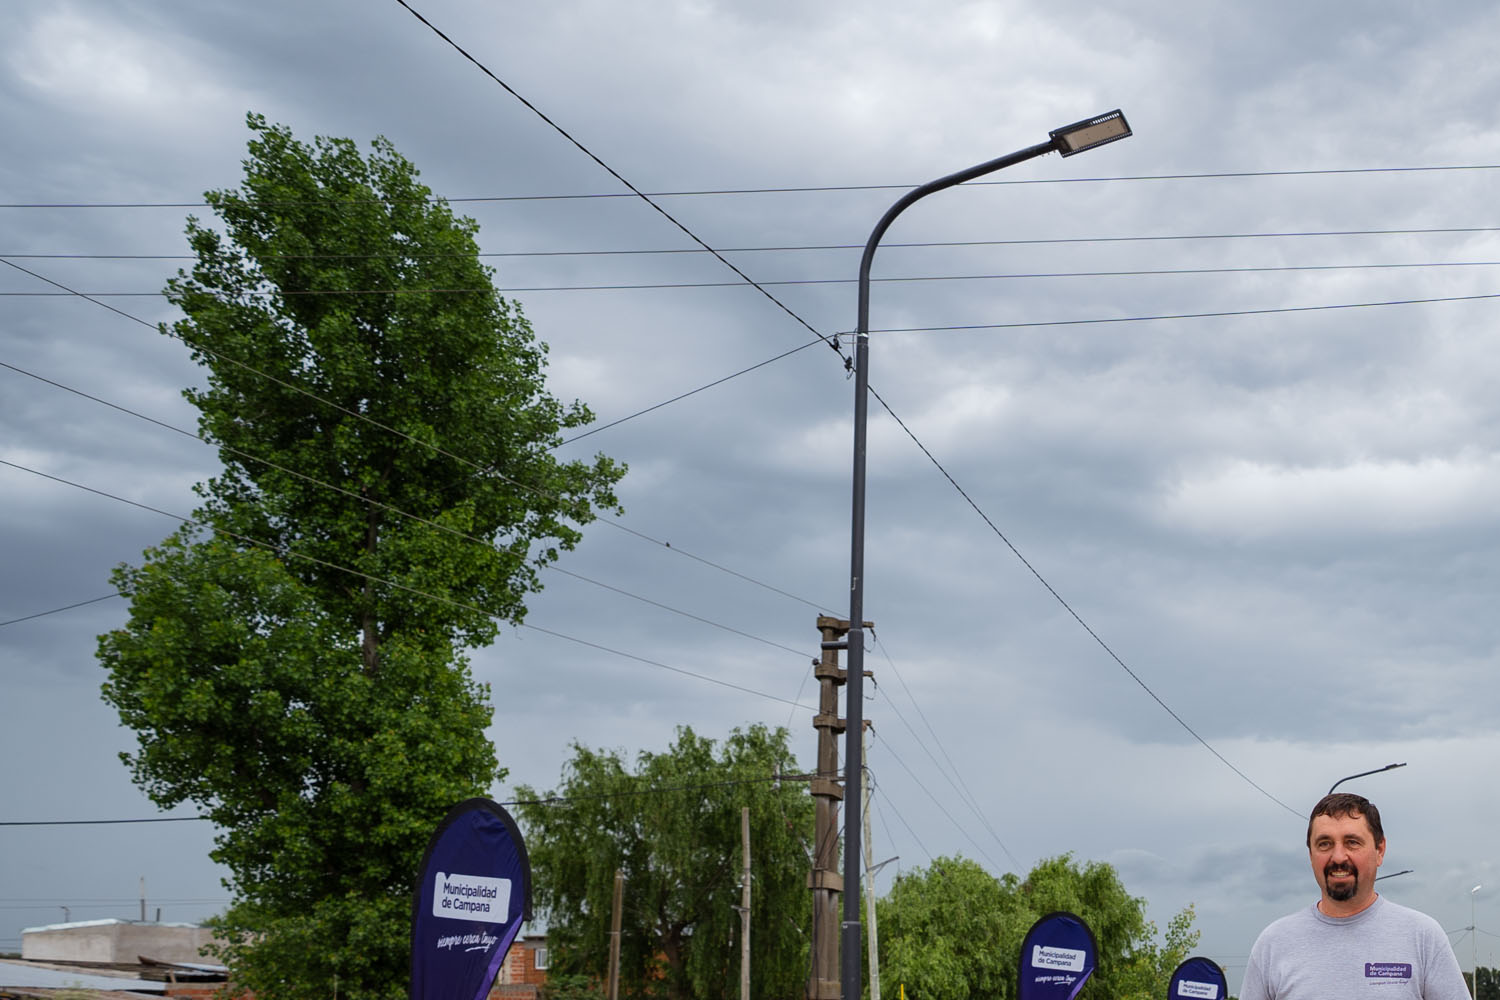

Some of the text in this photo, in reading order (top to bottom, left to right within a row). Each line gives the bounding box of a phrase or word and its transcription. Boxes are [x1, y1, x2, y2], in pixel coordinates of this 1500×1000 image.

[443, 882, 497, 899] Municipalidad
[442, 897, 490, 913] de Campana
[1039, 950, 1076, 960] Municipalidad
[1046, 958, 1071, 966] Campana
